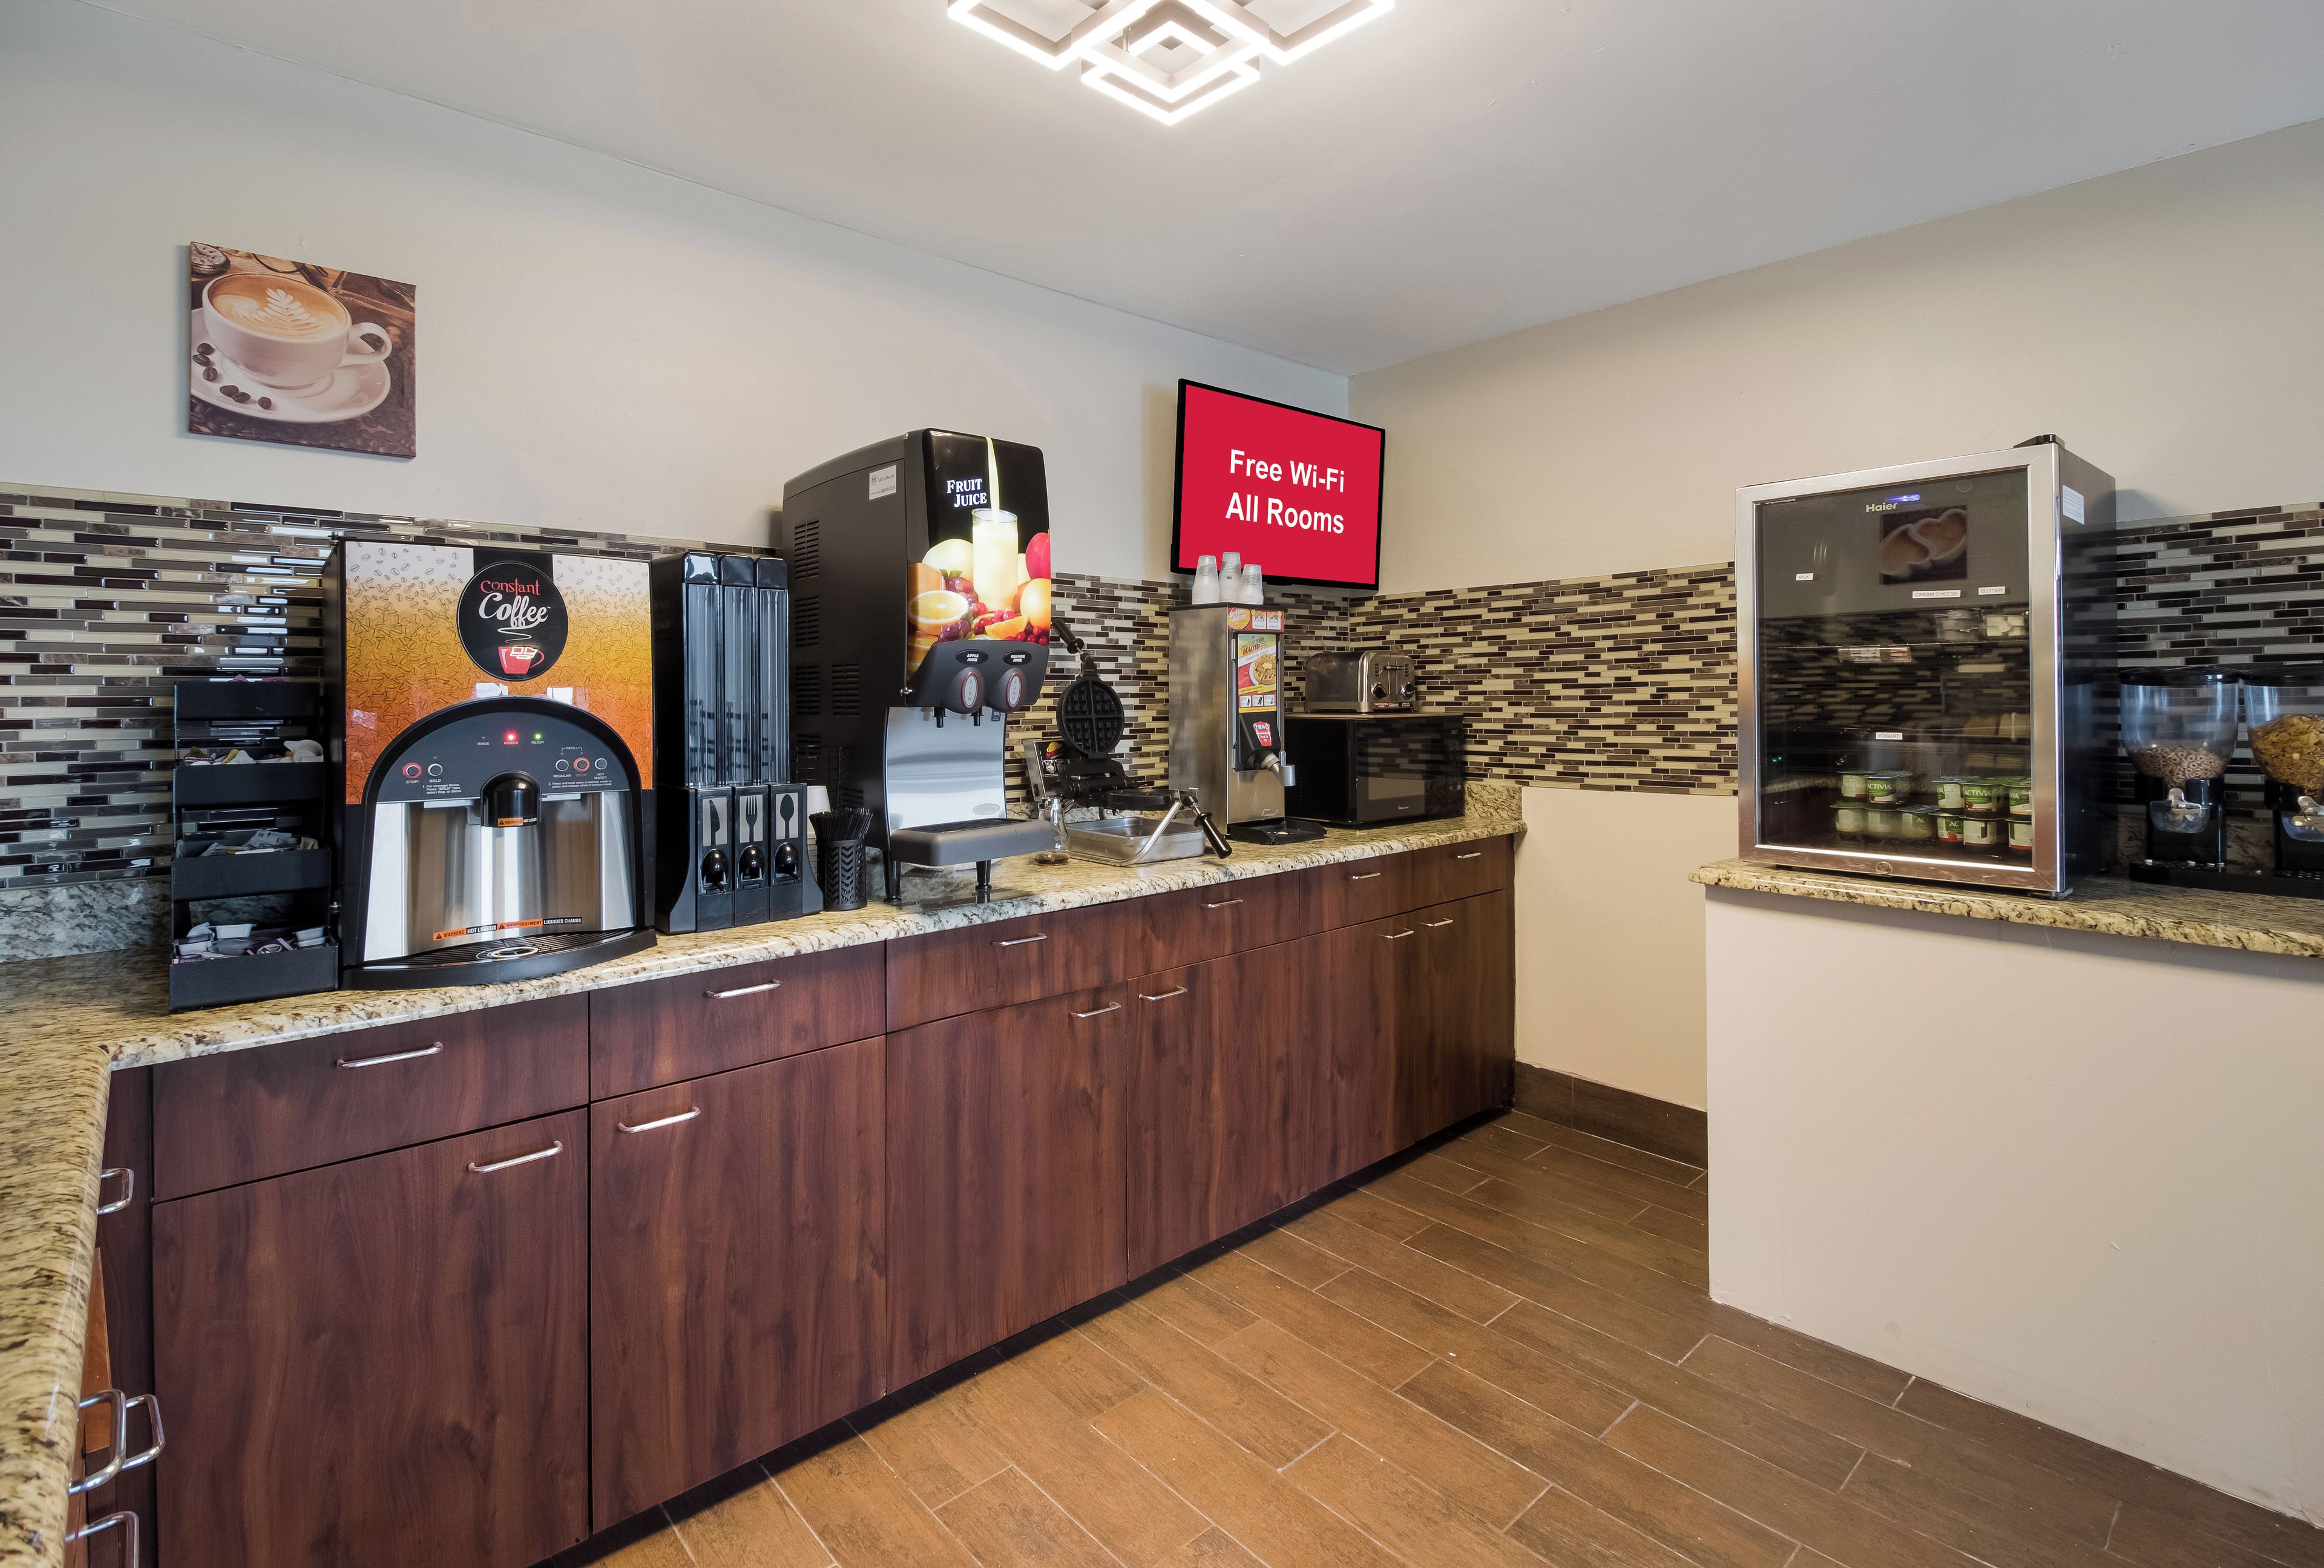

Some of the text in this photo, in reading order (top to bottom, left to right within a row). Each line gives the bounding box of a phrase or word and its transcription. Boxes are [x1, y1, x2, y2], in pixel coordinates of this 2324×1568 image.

[1230, 448, 1344, 493] Free Wi-Fi
[947, 478, 982, 493] FRUIT
[954, 493, 987, 507] JUICE
[1866, 502, 1897, 513] Haier
[1225, 492, 1344, 534] All Rooms
[479, 592, 549, 629] Coffee
[1242, 643, 1260, 655] MALTED
